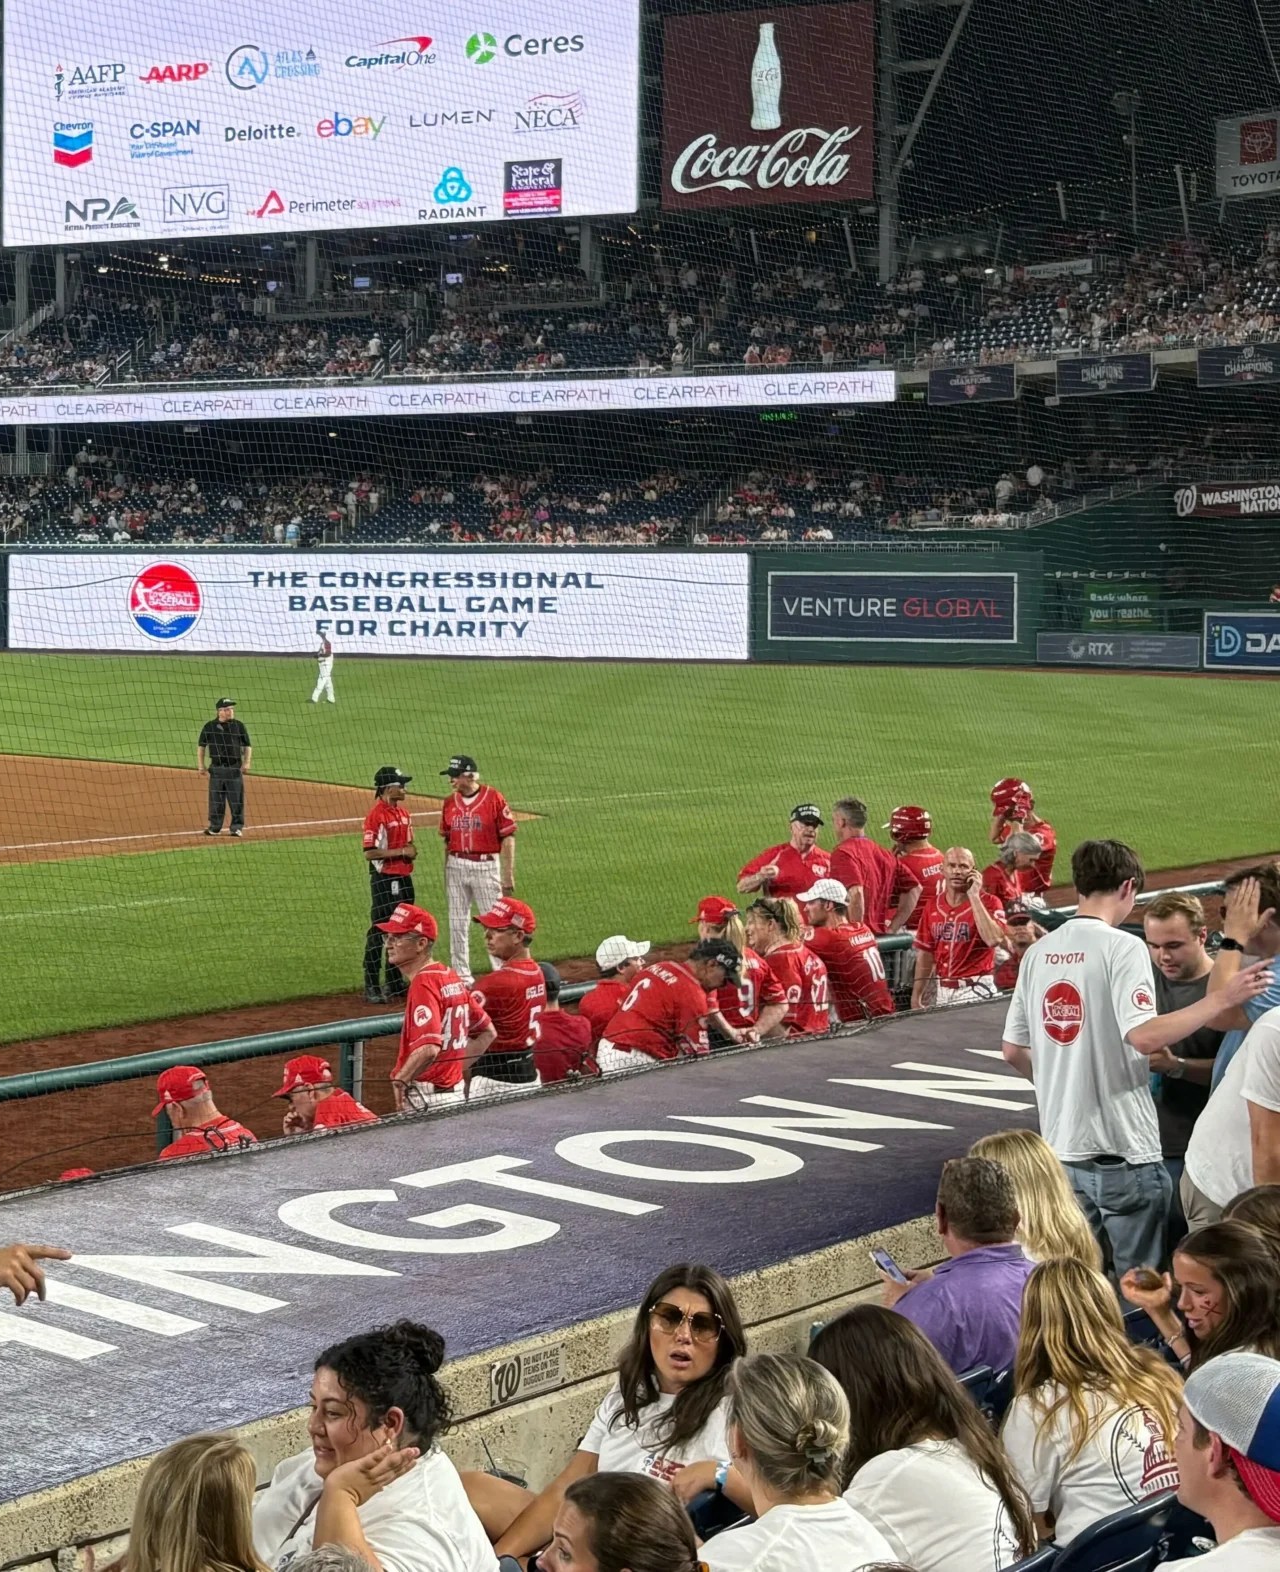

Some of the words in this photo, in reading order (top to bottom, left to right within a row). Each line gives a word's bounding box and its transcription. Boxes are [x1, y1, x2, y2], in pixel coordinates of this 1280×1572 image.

[504, 34, 584, 57] Ceres
[68, 63, 125, 86] AAFP
[139, 63, 209, 84] AARP
[53, 121, 93, 131] Chevron
[316, 111, 387, 140] ebay
[409, 109, 493, 128] LUMEN
[514, 108, 578, 130] NECA
[671, 126, 862, 194] Coca-Cola
[511, 164, 540, 178] State
[511, 173, 555, 187] Federal
[65, 197, 140, 223] NPA
[170, 191, 225, 216] NVG
[289, 199, 356, 214] Perimeter
[418, 206, 487, 221] RADIANT
[1225, 361, 1273, 376] CHAMPIONS
[56, 402, 143, 416] CLEARPATH
[162, 399, 253, 413] CLEARPATH
[273, 396, 368, 410] CLEARPATH
[388, 392, 486, 407] CLEARPATH
[508, 389, 609, 404] CLEARPATH
[633, 385, 739, 401] CLEARPATH
[764, 380, 873, 397] CLEARPATH
[1240, 498, 1280, 514] NATIO
[249, 571, 308, 588] THE
[319, 571, 605, 590] CONGRESSIONAL
[289, 595, 457, 613] BASEBALL
[465, 596, 558, 614] GAME
[782, 597, 897, 618] VENTURE
[902, 598, 1003, 618] GLOBAL
[1089, 608, 1109, 621] you
[316, 619, 377, 637] FOR
[388, 620, 530, 638] CHARITY
[1088, 642, 1113, 656] RTX
[451, 815, 483, 831] USA
[932, 921, 970, 942] USA
[863, 947, 886, 982] 10
[1045, 952, 1085, 965] TOYOTA
[622, 978, 651, 1012] 6
[526, 1005, 542, 1047] 5
[523, 1357, 531, 1366] DO
[532, 1353, 543, 1363] NOT
[543, 1347, 560, 1359] PLACE
[523, 1364, 540, 1377] ITEMS
[540, 1361, 548, 1370] ON
[549, 1357, 560, 1367] THE
[523, 1372, 545, 1387] DUGOUT
[546, 1367, 560, 1379] ROOF
